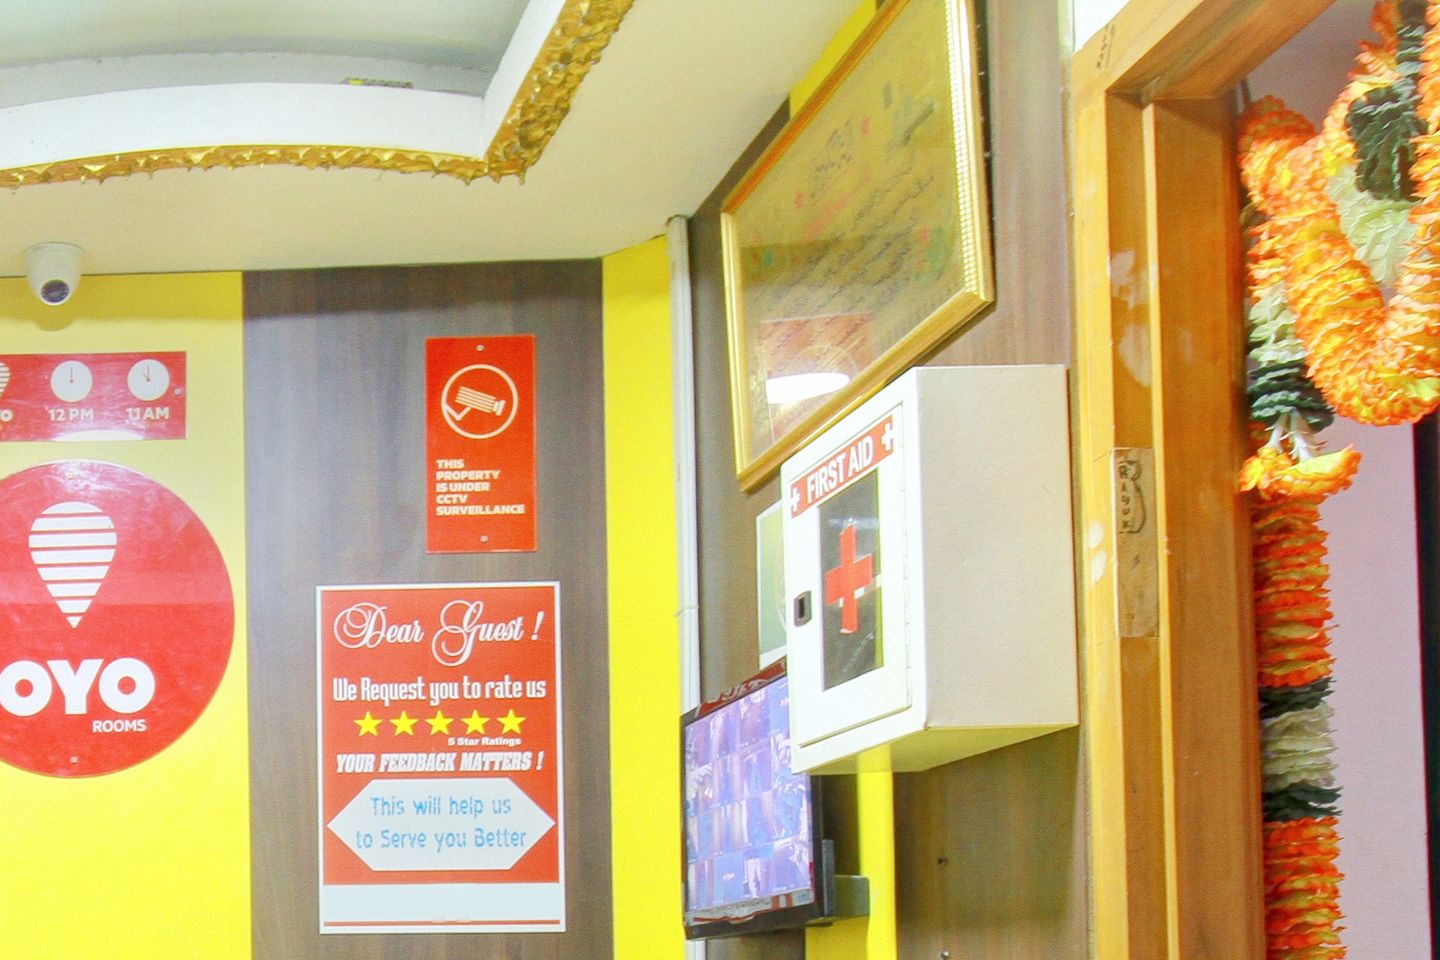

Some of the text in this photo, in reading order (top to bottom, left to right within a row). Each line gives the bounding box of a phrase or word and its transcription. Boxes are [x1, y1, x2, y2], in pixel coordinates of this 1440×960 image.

[48, 408, 94, 421] 12 PM
[143, 407, 170, 420] AM
[436, 459, 464, 469] THIS
[806, 436, 873, 504] FIRST AID
[436, 470, 501, 480] PROPERTY
[436, 481, 490, 492] IS UNDER
[436, 494, 467, 504] CCTV
[436, 505, 525, 516] SURVEILLANCE
[333, 600, 545, 667] Dear Guest !
[333, 675, 546, 707] We Request you to rate us
[92, 719, 147, 733] ROOMS
[448, 737, 521, 747] 5 Star Ratings
[336, 751, 544, 773] YOUR FEEDBACK MATTERS !
[370, 796, 511, 820] This will help us
[355, 828, 527, 853] to Serve you Better
